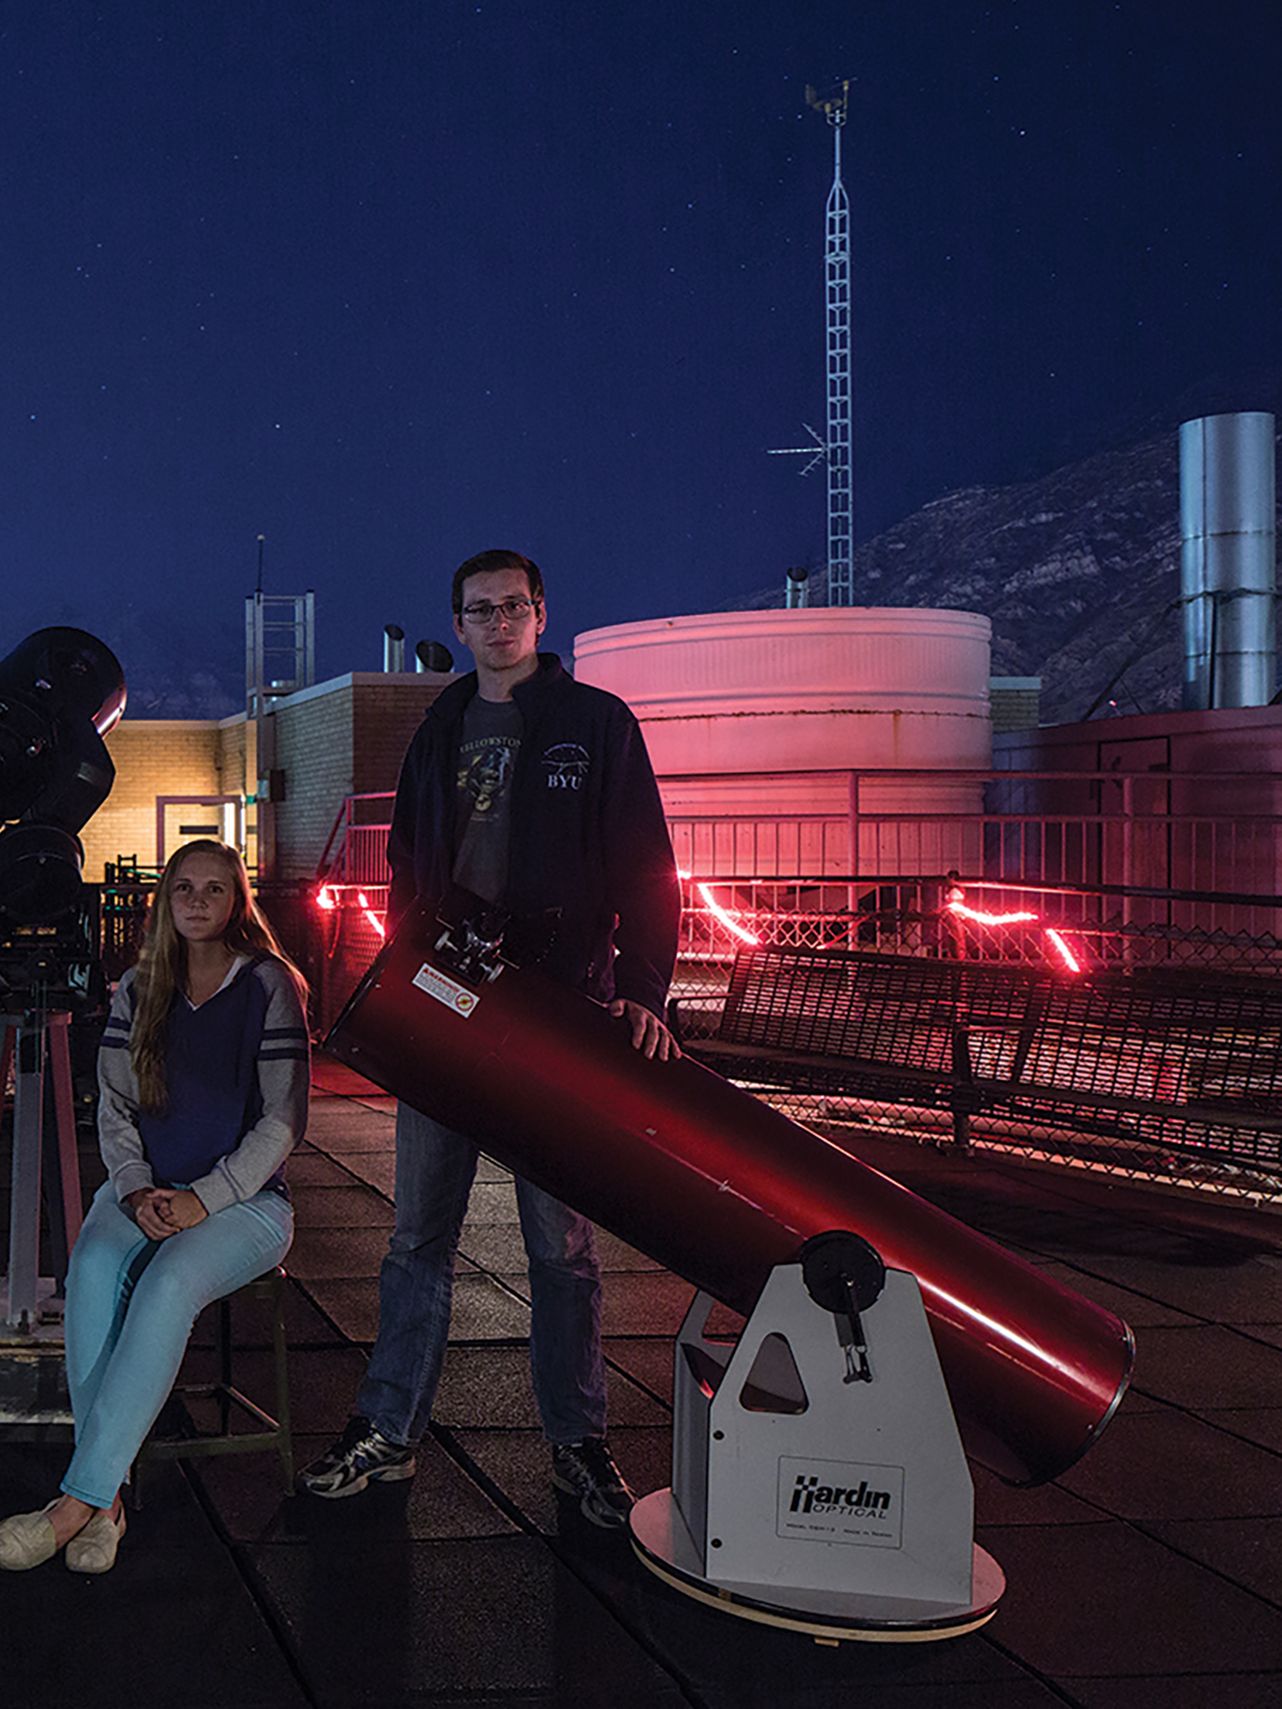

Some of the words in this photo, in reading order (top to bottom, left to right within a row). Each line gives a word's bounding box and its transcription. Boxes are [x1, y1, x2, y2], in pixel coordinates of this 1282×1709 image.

[547, 774, 582, 790] BYU
[790, 1475, 891, 1513] Hardin
[812, 1504, 887, 1519] OPTICAL
